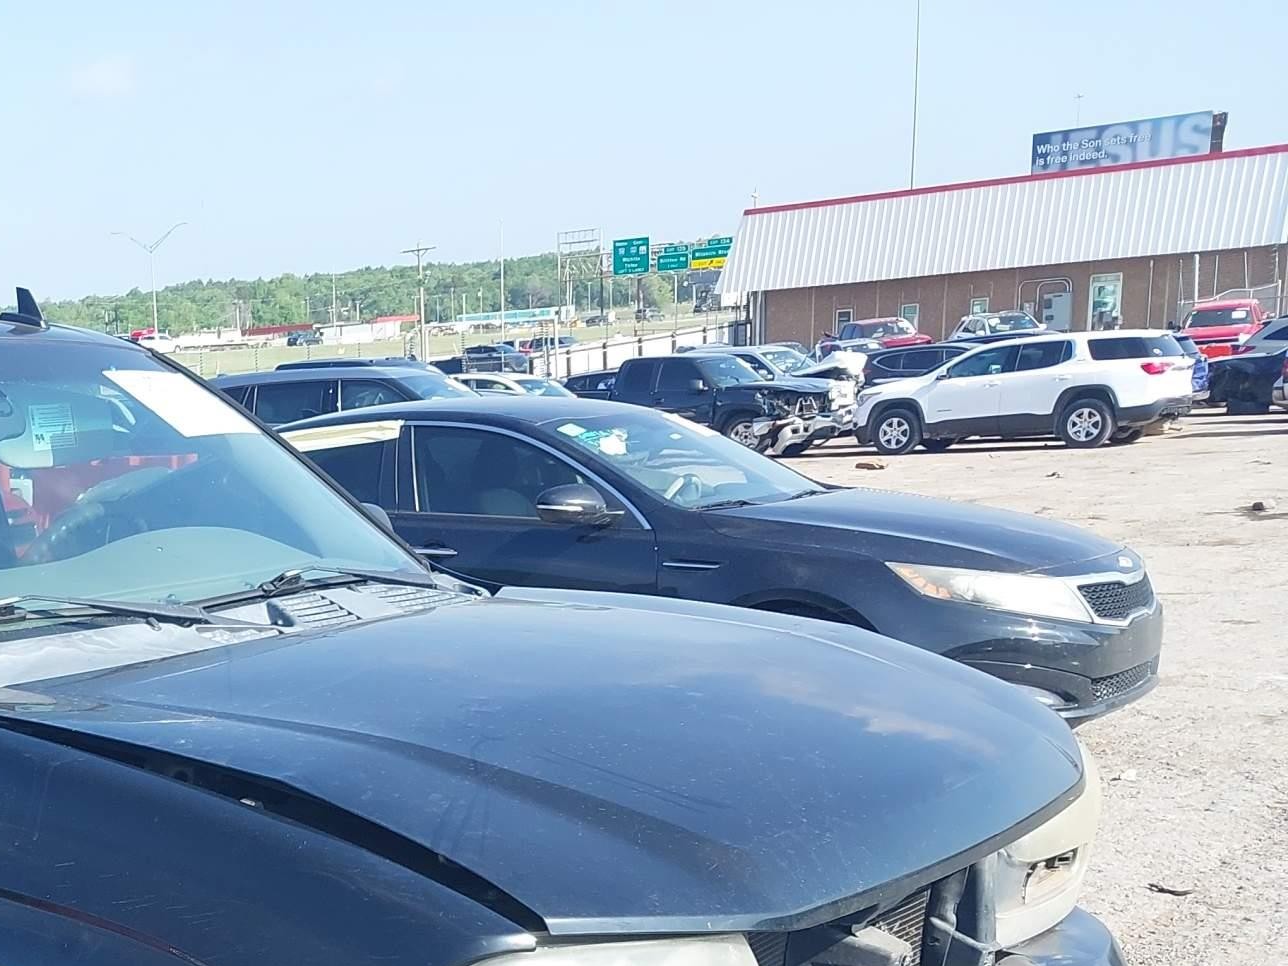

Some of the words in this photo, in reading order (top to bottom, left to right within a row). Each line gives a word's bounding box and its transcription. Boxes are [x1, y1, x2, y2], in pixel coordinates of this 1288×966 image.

[1036, 143, 1060, 155] Who
[1062, 140, 1079, 151] the
[1081, 138, 1102, 149] Son
[1035, 156, 1045, 166] is
[1046, 154, 1068, 165] free
[1069, 149, 1108, 162] indeed.
